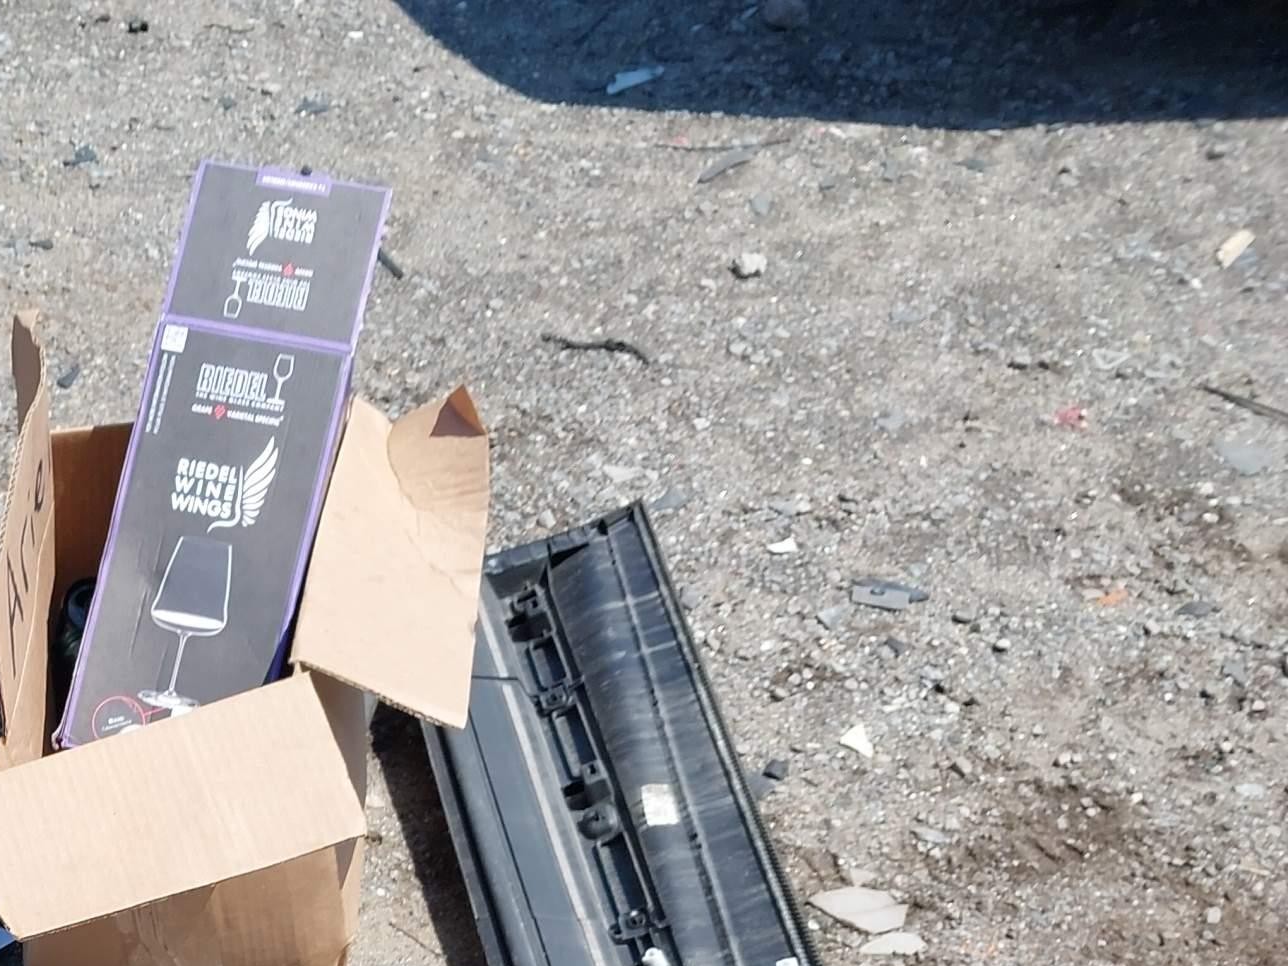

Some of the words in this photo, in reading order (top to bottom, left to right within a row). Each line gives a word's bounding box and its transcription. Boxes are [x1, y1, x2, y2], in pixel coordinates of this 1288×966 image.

[196, 363, 268, 402] RIEDEL
[177, 458, 237, 483] RIEDEL
[175, 475, 236, 502] WINE
[172, 492, 232, 519] WINGS
